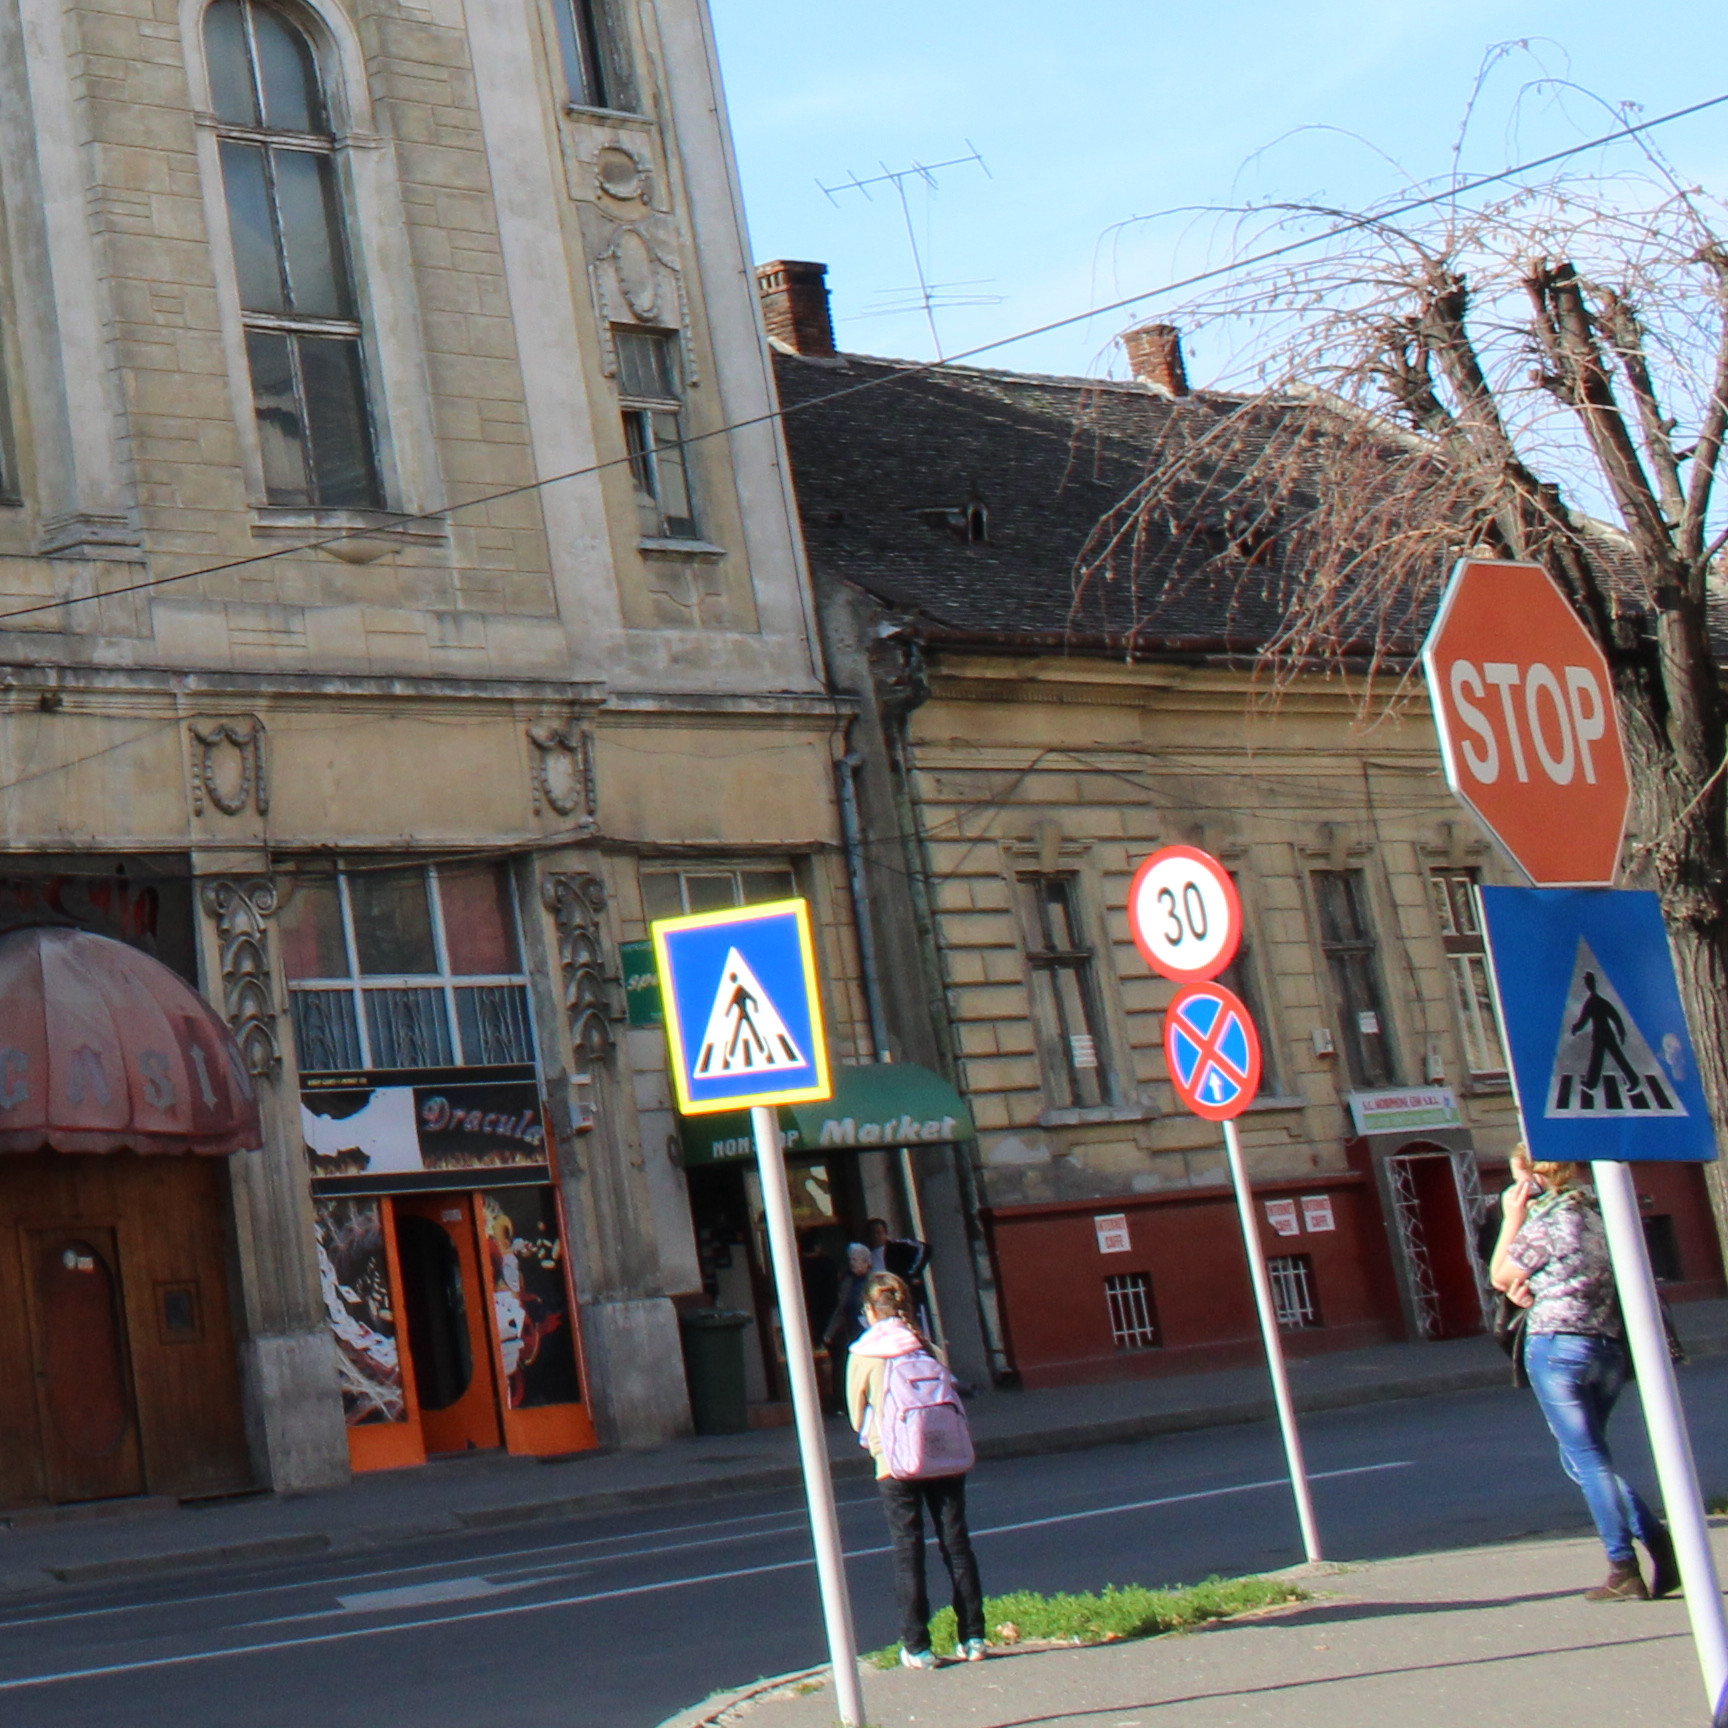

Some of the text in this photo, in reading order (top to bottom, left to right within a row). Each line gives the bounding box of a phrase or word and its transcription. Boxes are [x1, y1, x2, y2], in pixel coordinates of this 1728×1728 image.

[1450, 659, 1605, 786] STOP
[1156, 879, 1208, 947] 30
[421, 1096, 544, 1146] Dracula
[819, 1114, 957, 1145] Market
